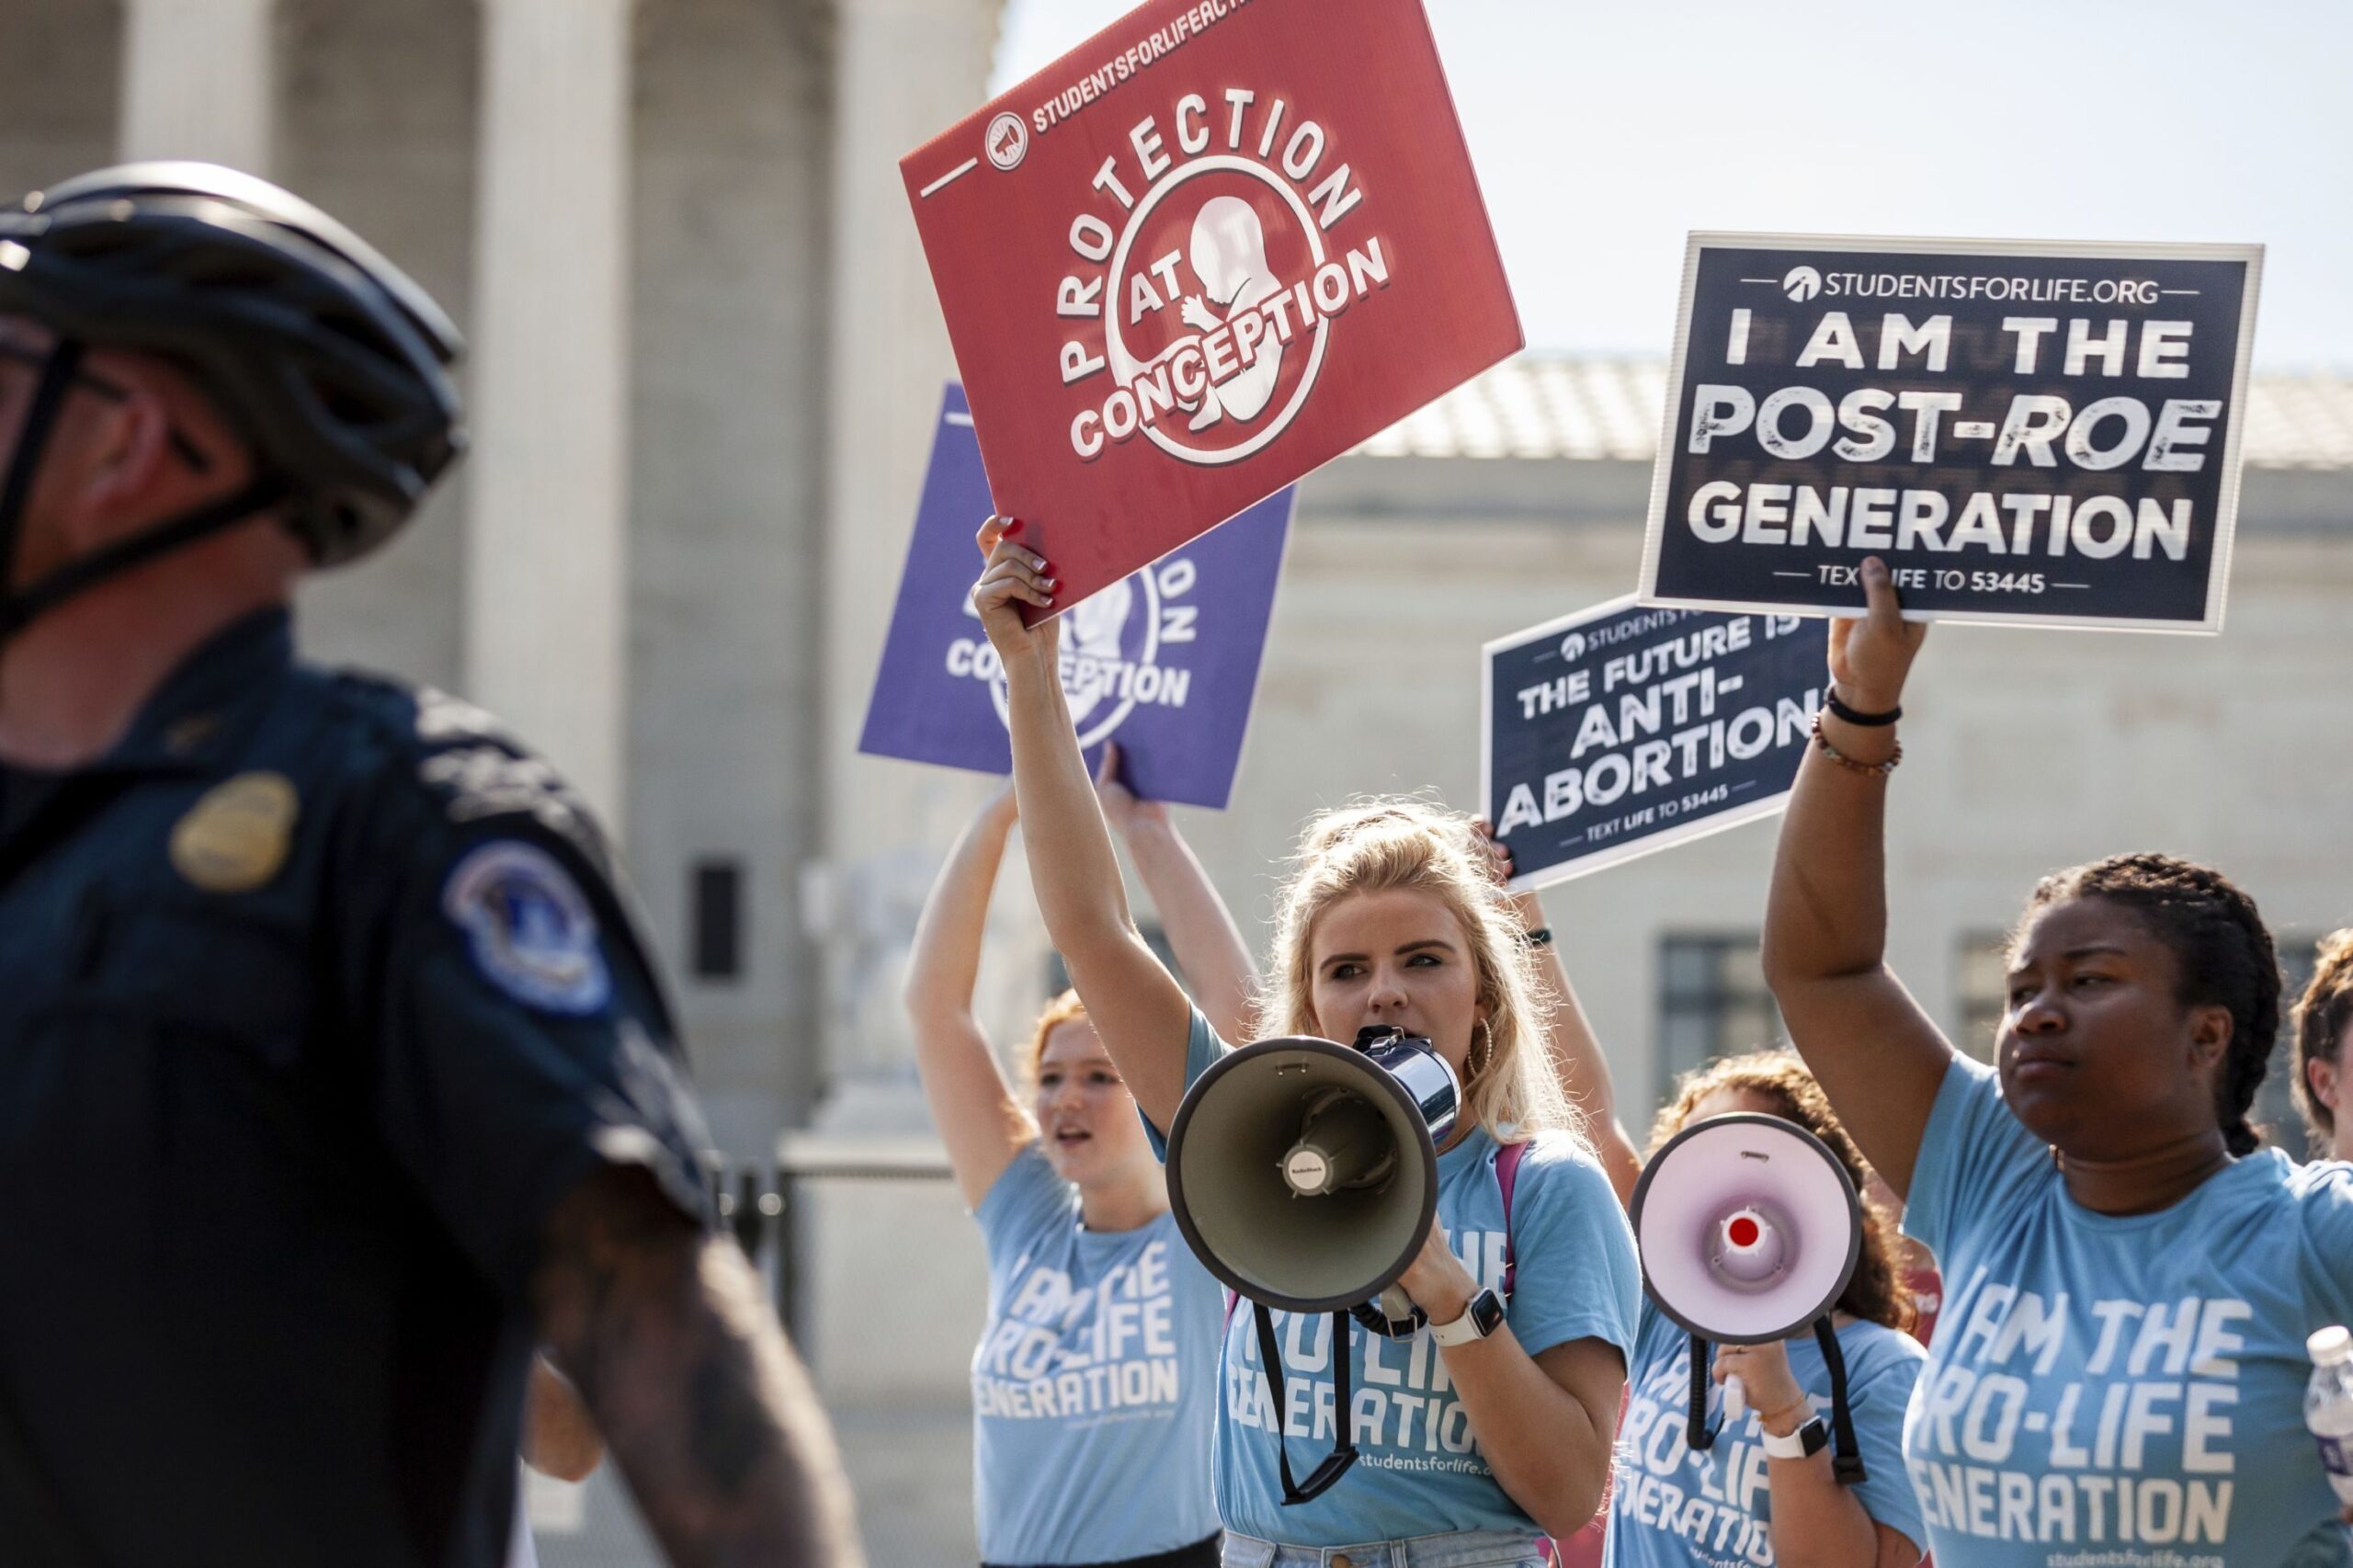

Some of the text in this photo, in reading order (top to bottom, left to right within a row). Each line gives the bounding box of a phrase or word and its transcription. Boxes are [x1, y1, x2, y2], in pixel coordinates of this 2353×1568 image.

[1057, 88, 1362, 384] PROTECTION
[1129, 250, 1183, 325] AT
[1824, 272, 2159, 304] STUDENTSFORLIFE.ORG
[1070, 236, 1389, 458] CONCEPTION
[1726, 308, 2194, 379] I AM THE
[1688, 384, 2222, 472] POST-ROE
[1687, 480, 2193, 561] GENERATION
[1818, 564, 2046, 595] TEX IFE TO 53445
[1518, 669, 1591, 720] THE
[1604, 615, 1751, 693] FUTURE
[1570, 666, 1744, 759] ANTI-
[1495, 687, 1820, 837] ABORTION
[1586, 783, 1729, 842] TEXT LIFE TO 53445
[1954, 1283, 2069, 1376] AM
[2086, 1297, 2253, 1378] THE
